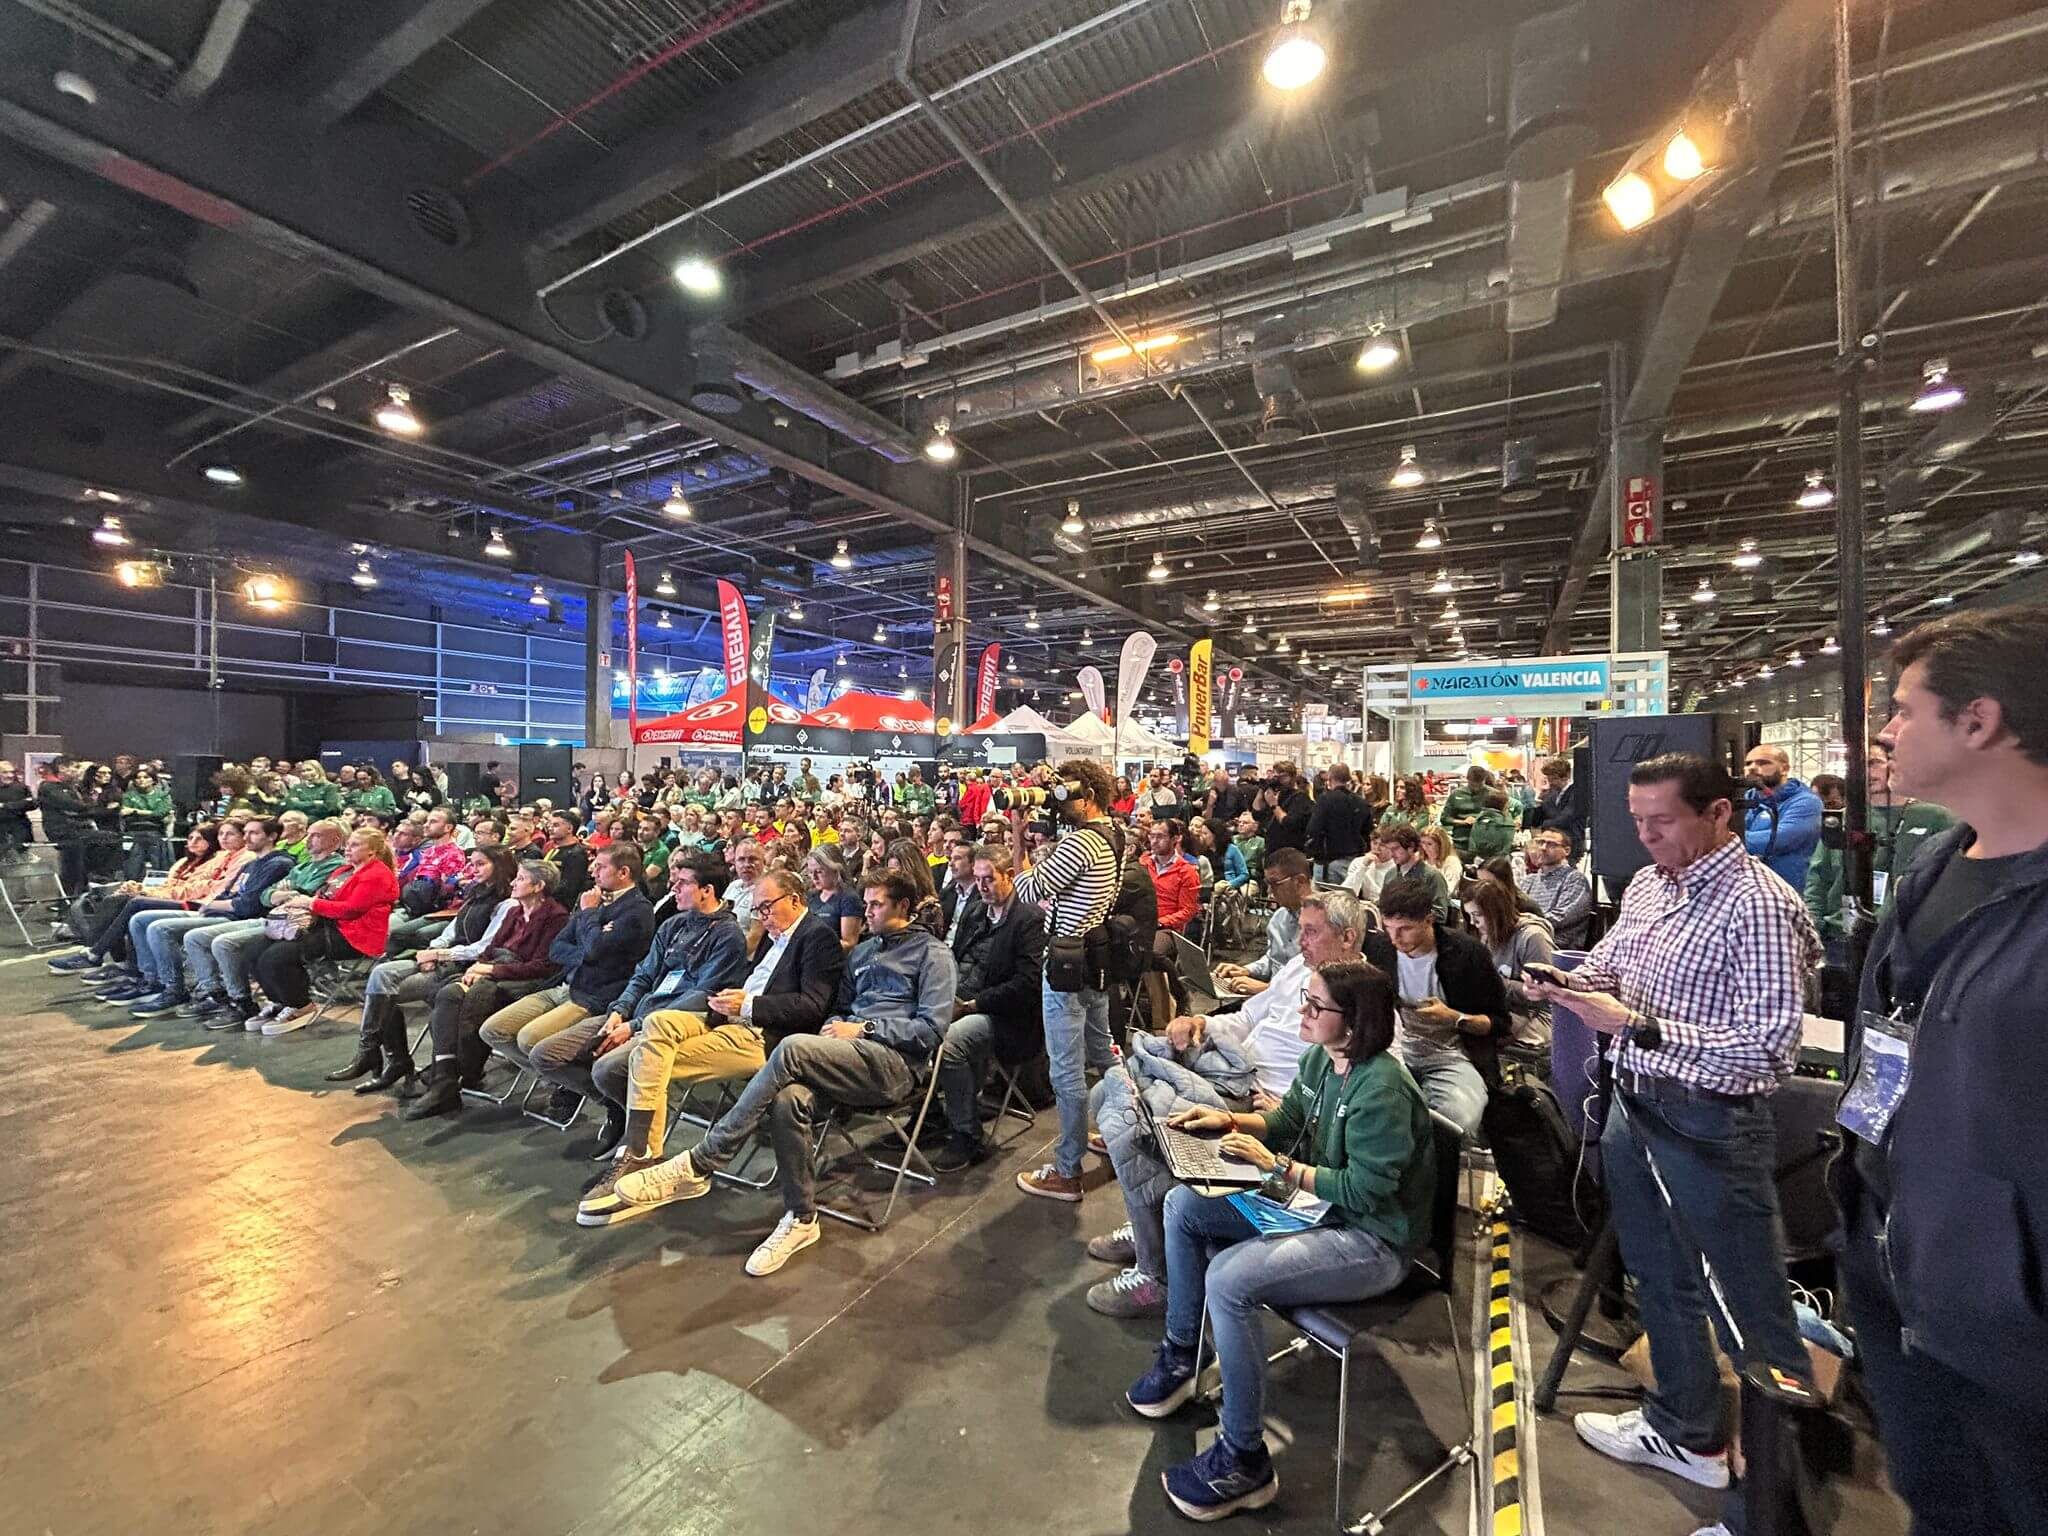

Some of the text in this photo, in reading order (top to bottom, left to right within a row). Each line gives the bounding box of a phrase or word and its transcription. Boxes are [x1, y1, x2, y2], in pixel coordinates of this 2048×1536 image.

[1431, 670, 1602, 690] MARATÓN VALENCIA
[1191, 654, 1210, 739] PowerBar
[773, 744, 829, 753] RONHILL
